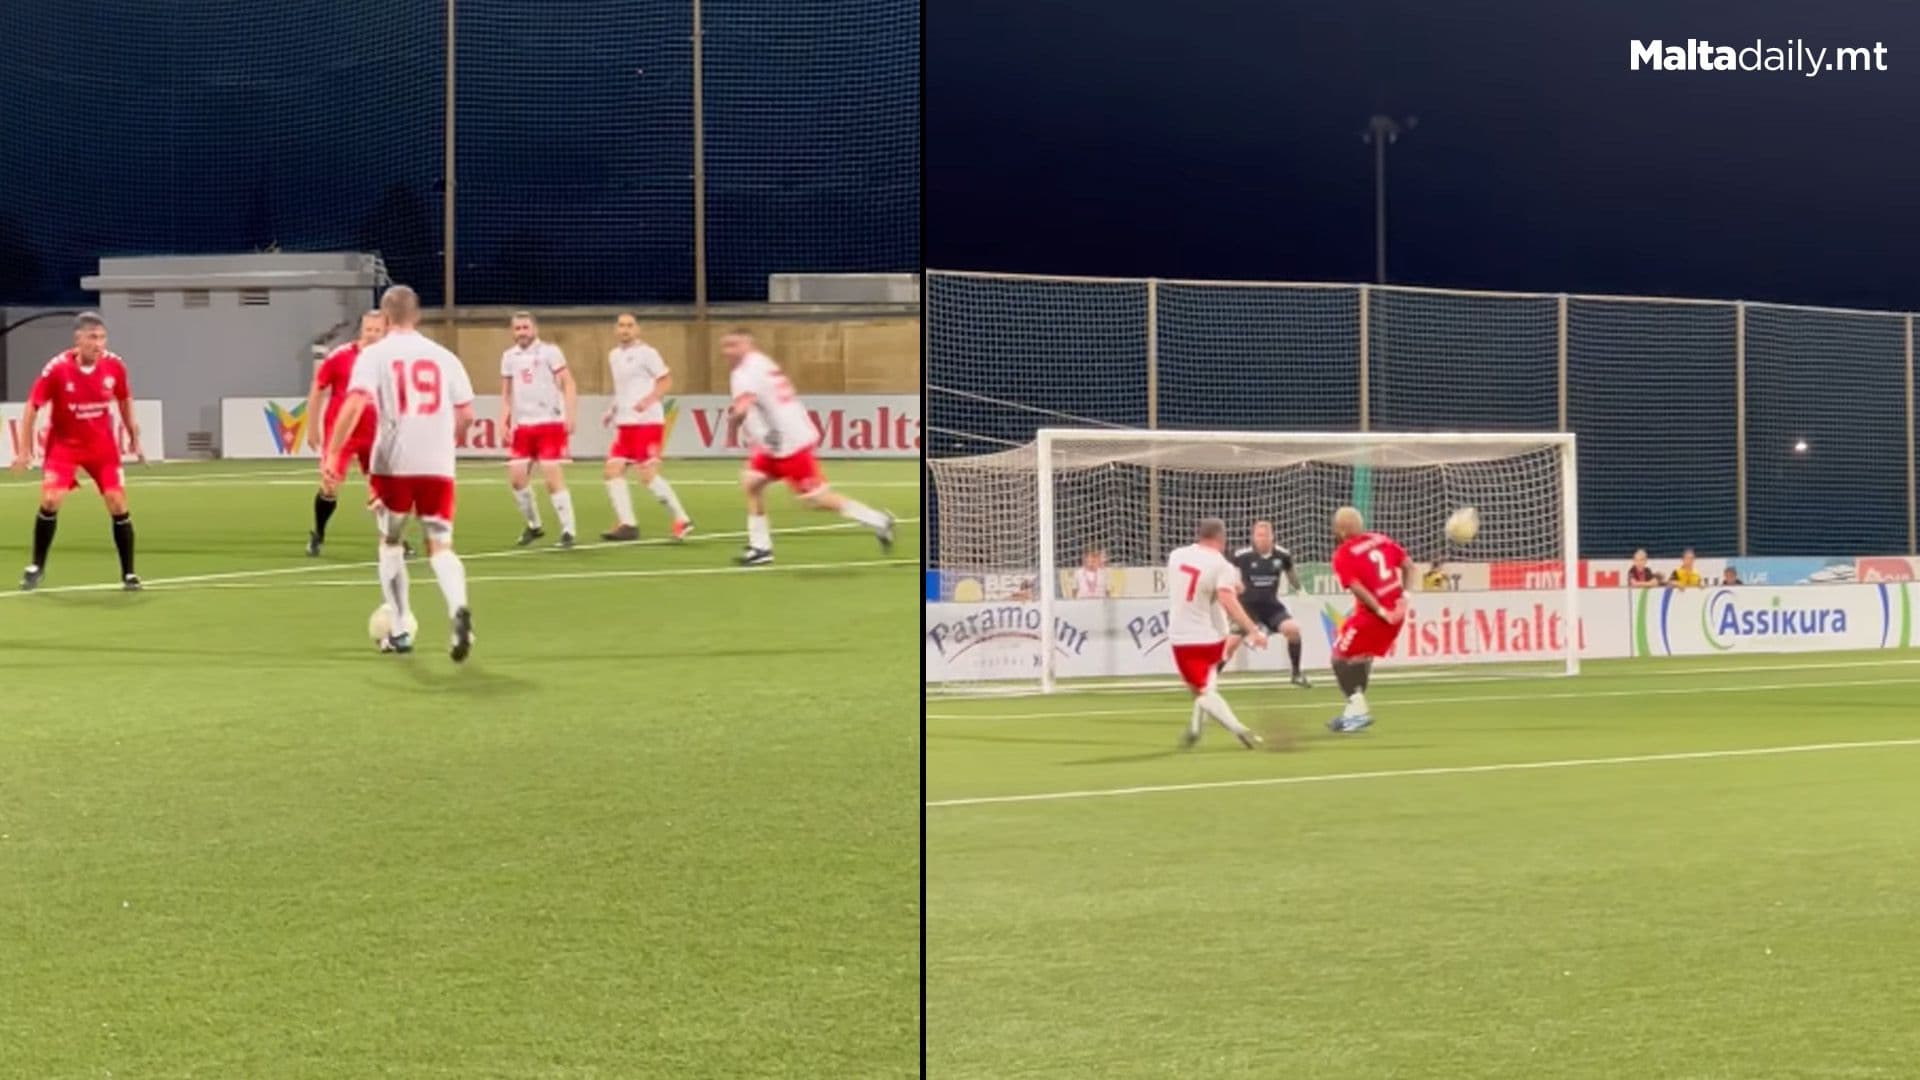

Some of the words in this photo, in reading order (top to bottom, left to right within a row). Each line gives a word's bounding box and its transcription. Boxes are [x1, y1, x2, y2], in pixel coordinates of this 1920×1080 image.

[392, 359, 441, 415] 19
[1179, 564, 1201, 601] 7
[1368, 549, 1392, 580] 2
[1718, 596, 1847, 636] Assikura
